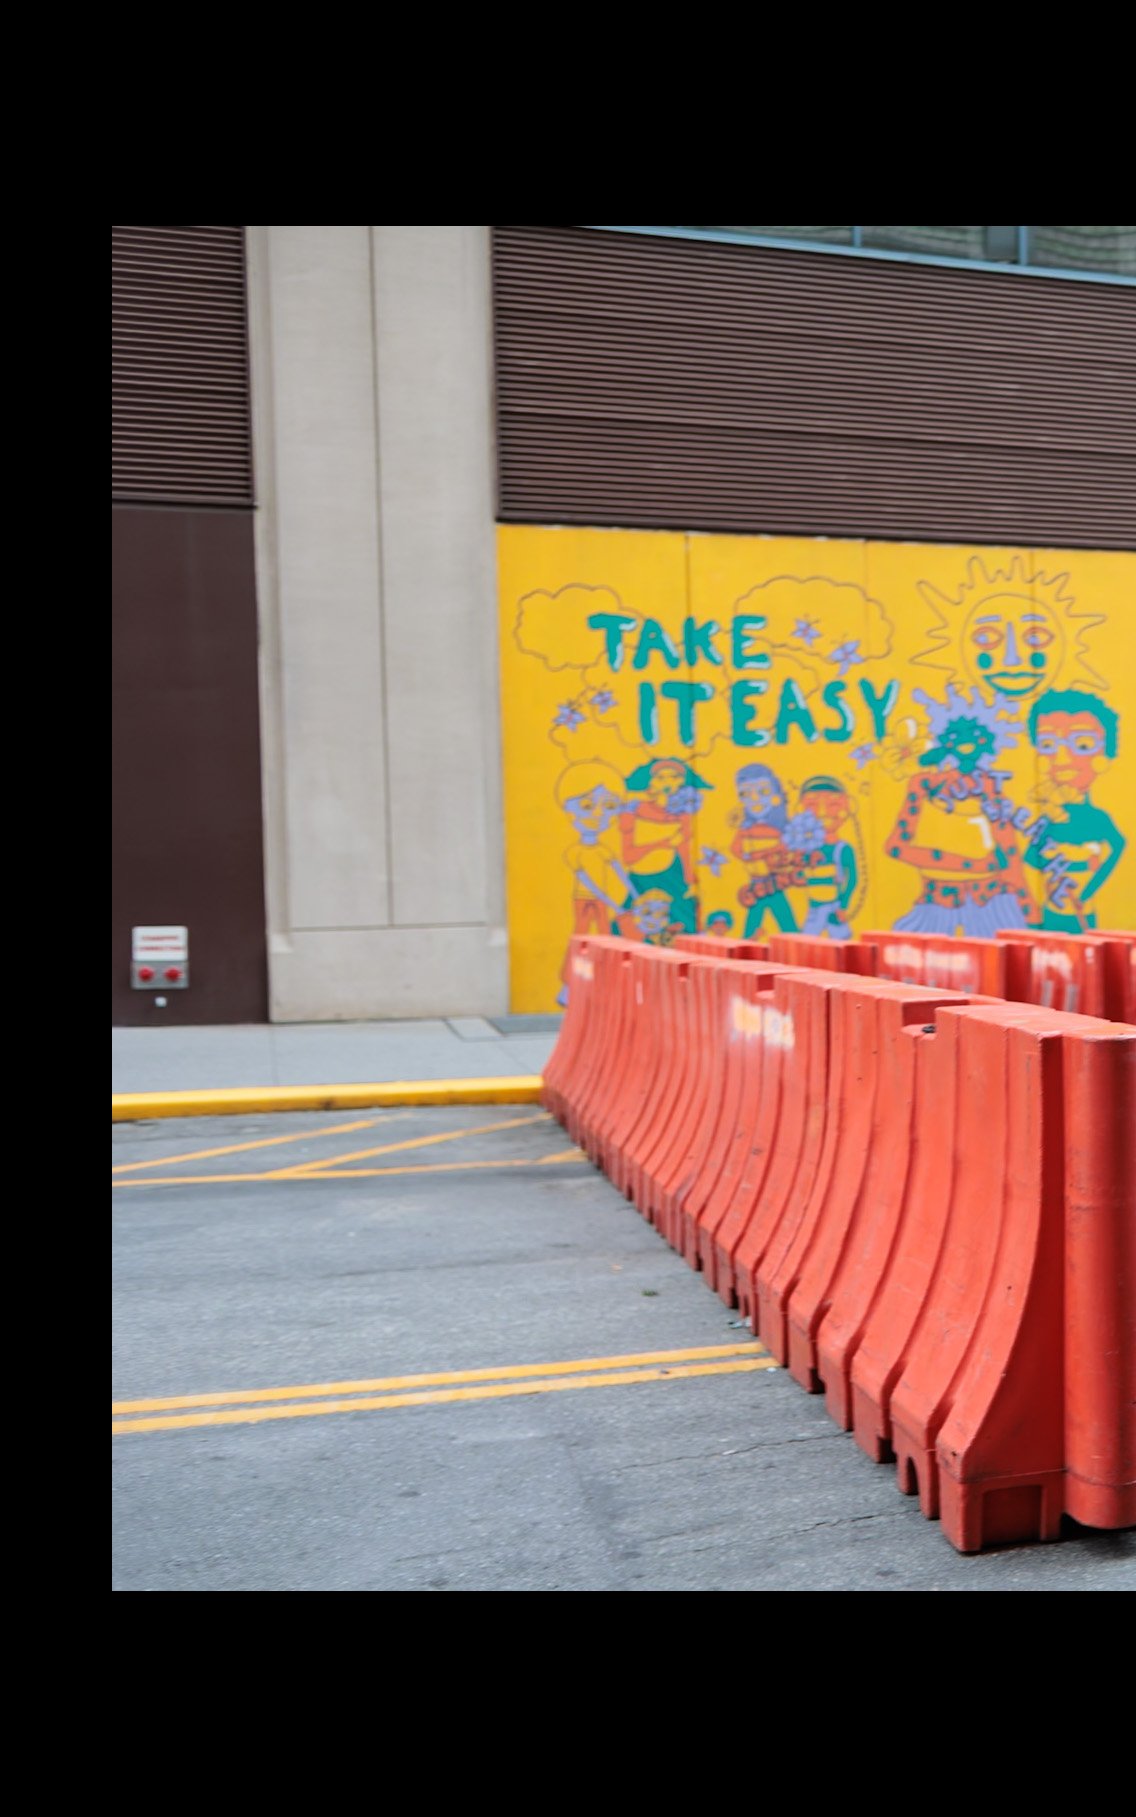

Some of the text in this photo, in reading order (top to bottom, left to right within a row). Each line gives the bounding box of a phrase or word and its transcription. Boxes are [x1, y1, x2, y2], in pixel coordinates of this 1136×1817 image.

[588, 613, 771, 671] TAKE
[638, 678, 900, 746] IT EASY
[935, 768, 1013, 814] JUST
